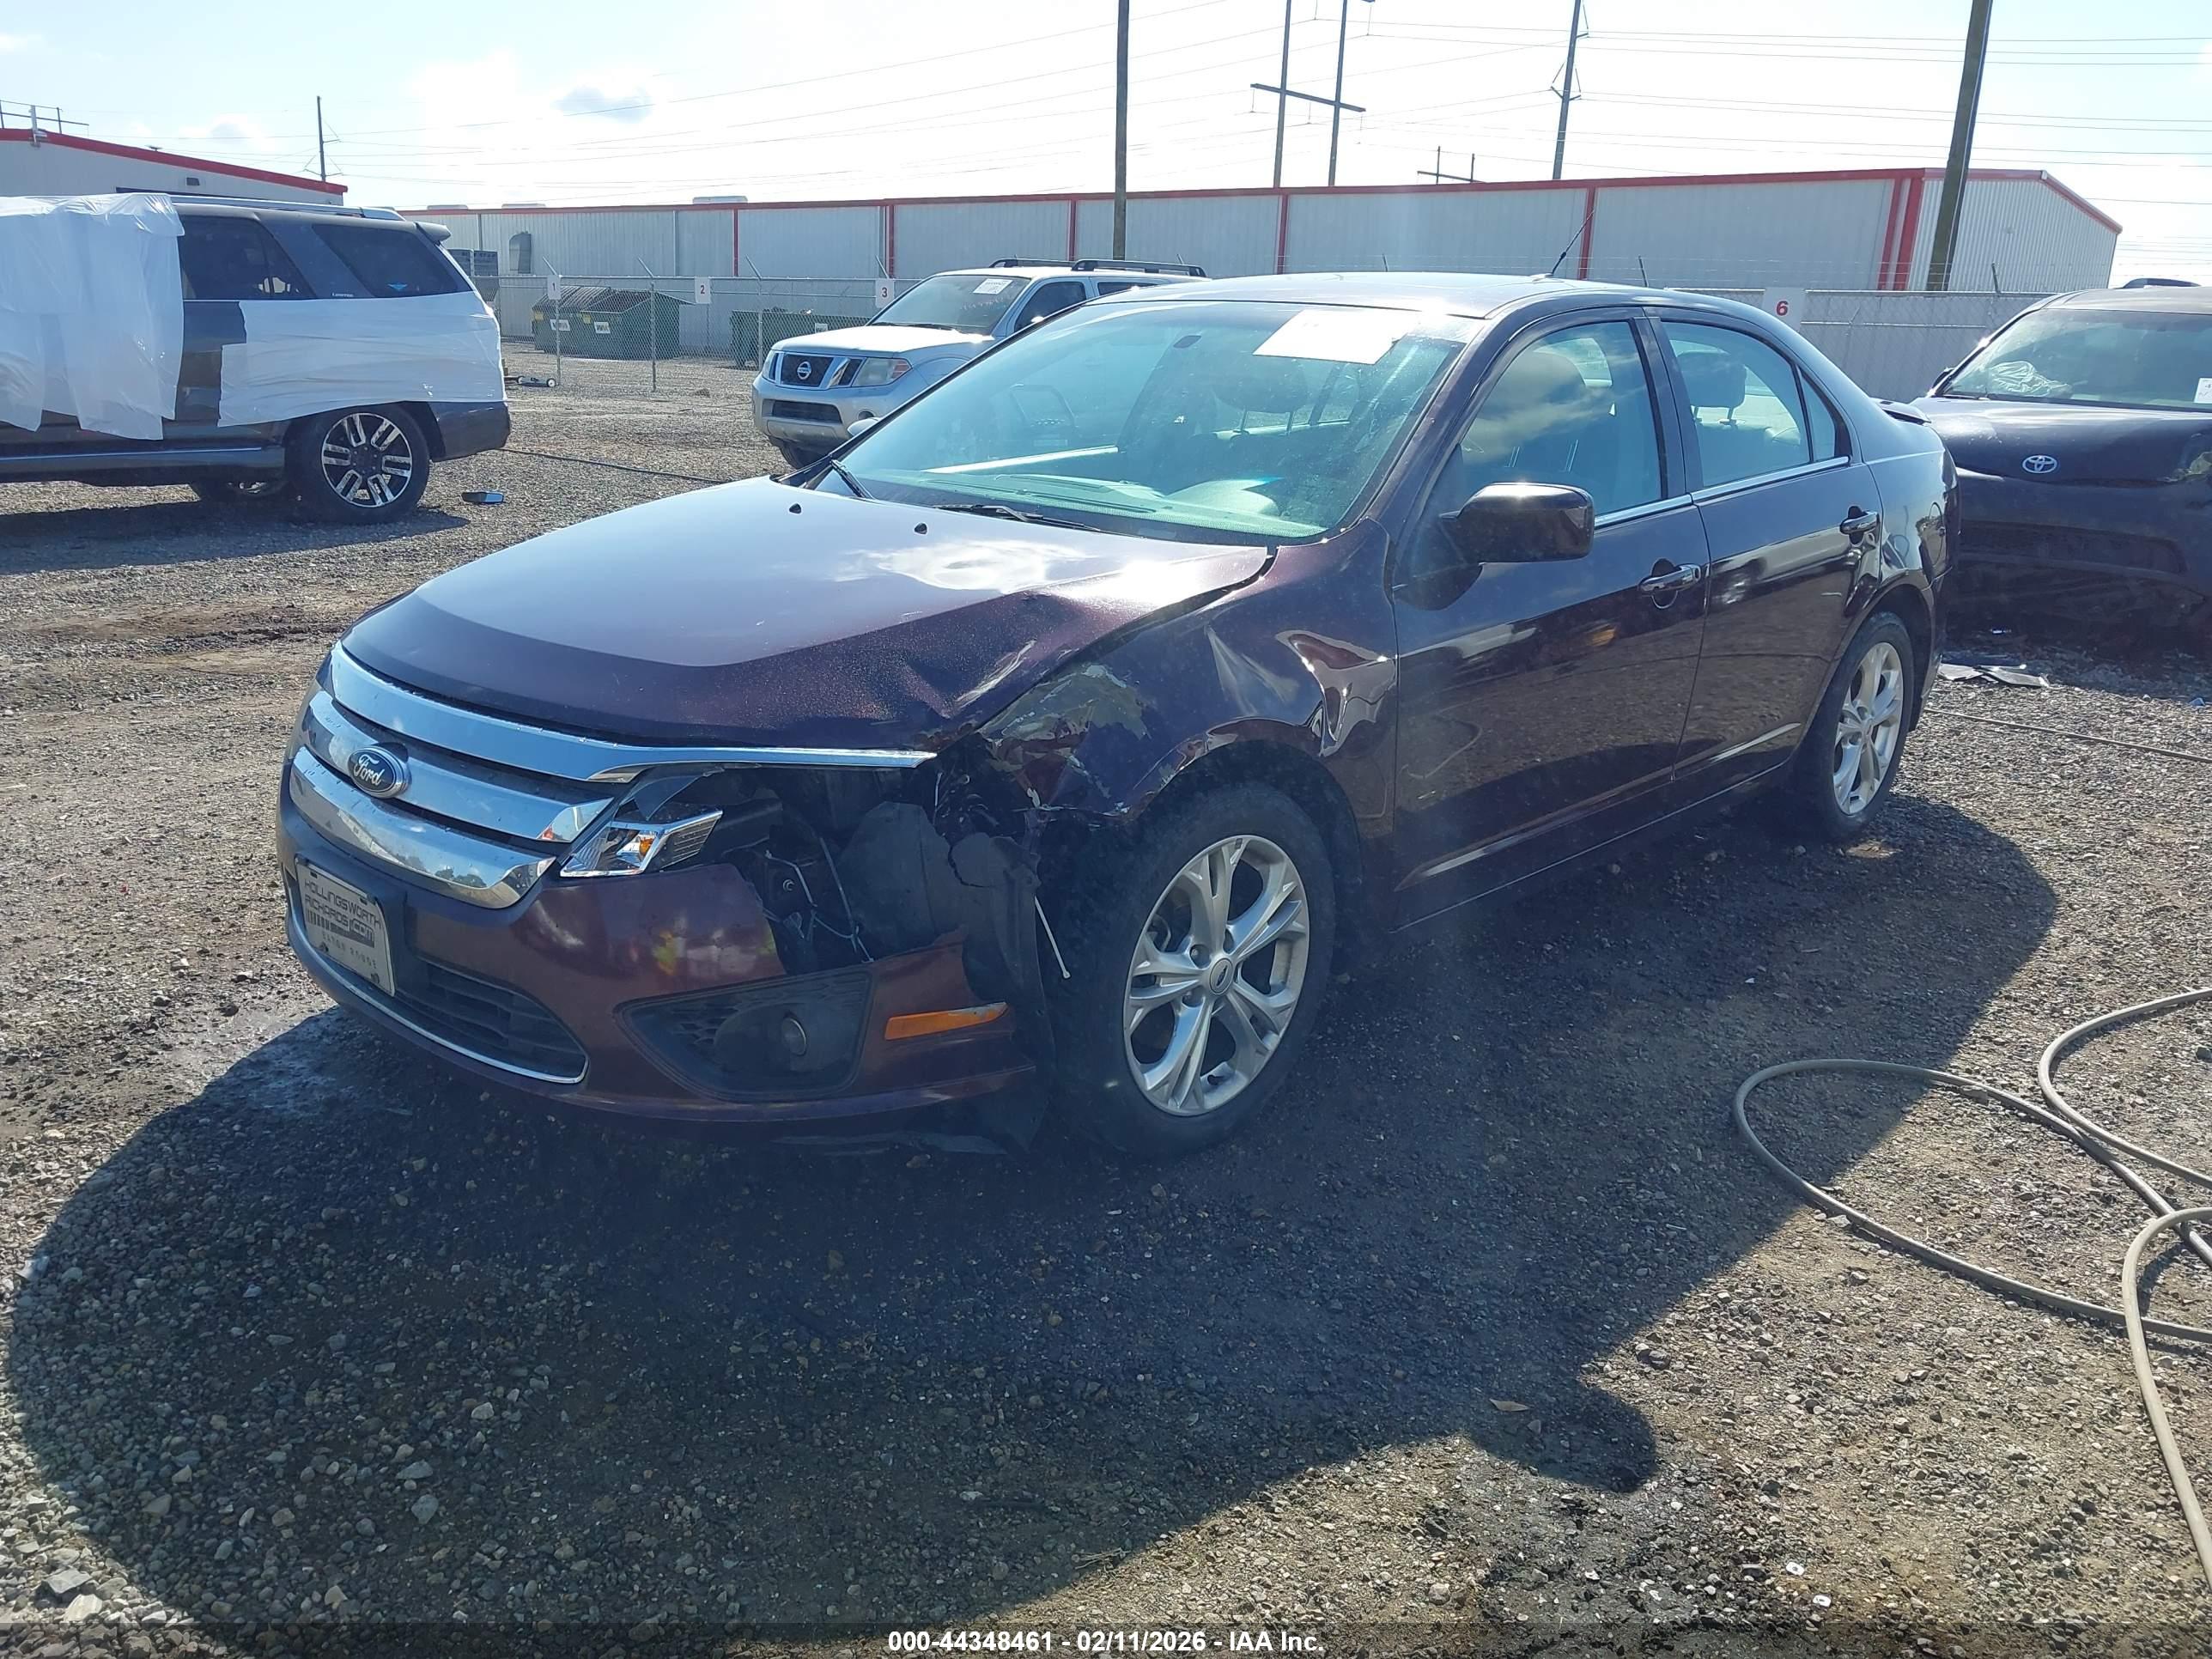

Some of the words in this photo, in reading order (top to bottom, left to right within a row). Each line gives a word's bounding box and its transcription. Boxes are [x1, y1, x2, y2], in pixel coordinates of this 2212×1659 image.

[700, 284, 705, 295] 2
[881, 287, 888, 298] 3
[1776, 301, 1789, 316] 6
[353, 754, 386, 786] Ford
[304, 878, 381, 930] HOLLINGSWORTH
